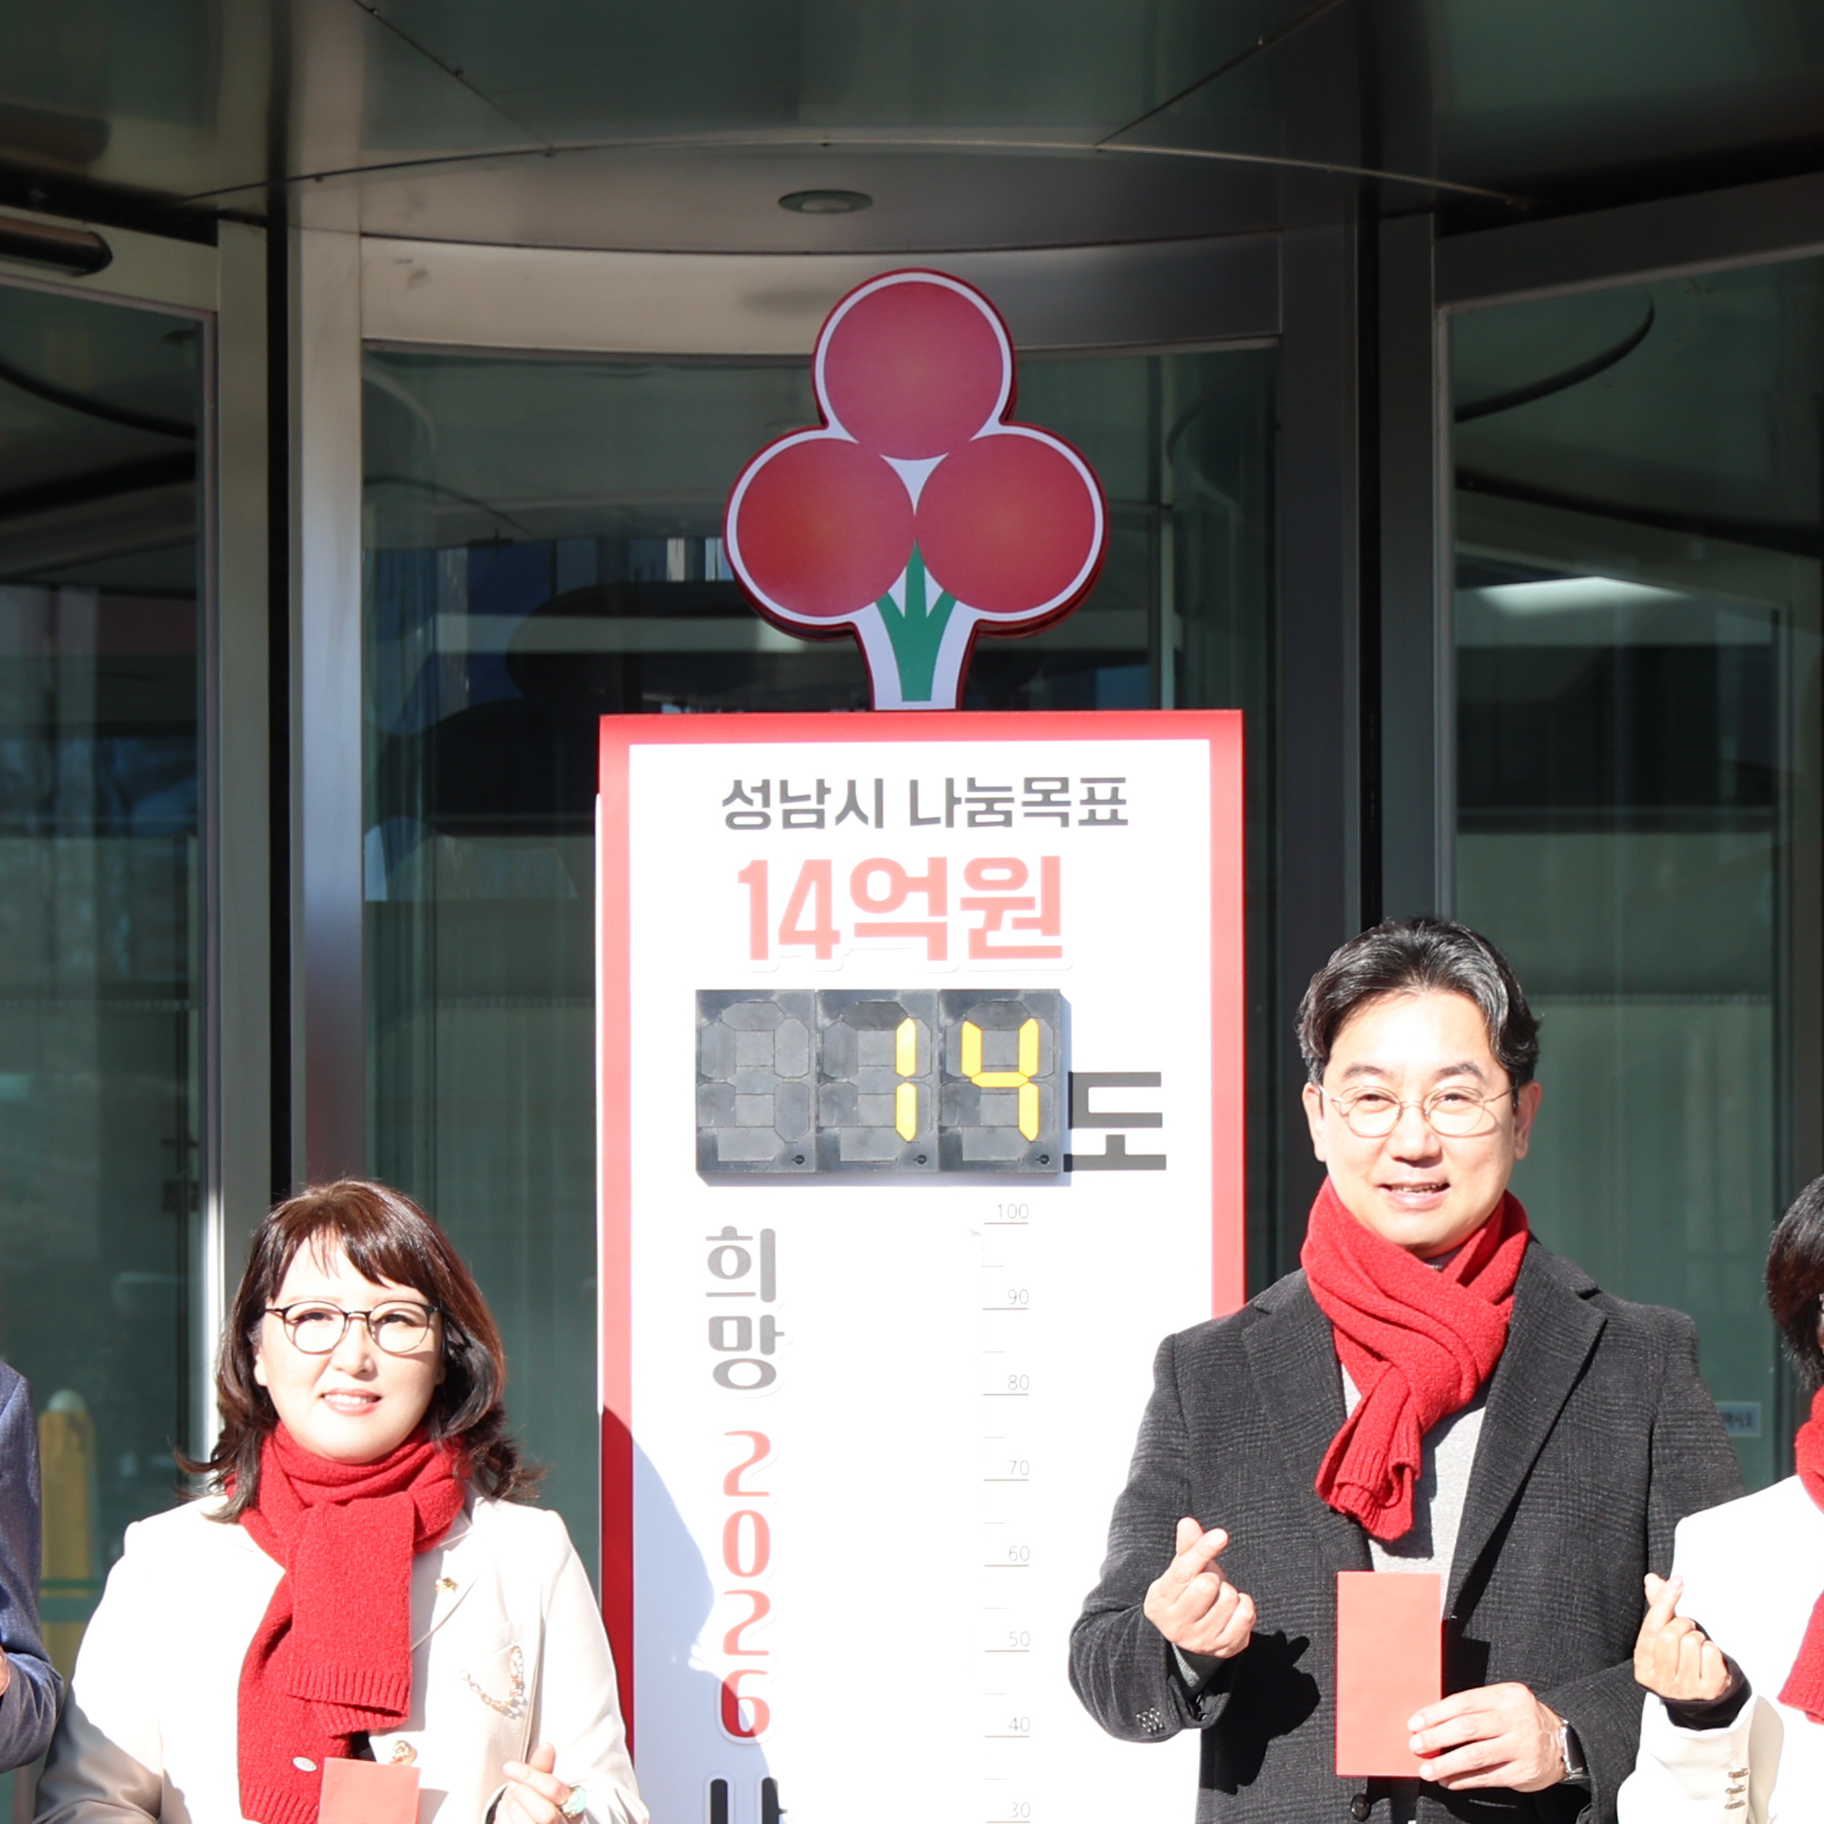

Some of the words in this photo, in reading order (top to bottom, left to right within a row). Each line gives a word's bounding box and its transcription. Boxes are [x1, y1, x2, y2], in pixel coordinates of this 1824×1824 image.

[722, 778, 884, 830] 성남시
[910, 777, 1128, 828] 나눔목표
[738, 856, 1062, 961] 14억원
[896, 1018, 1040, 1141] 14
[1063, 1071, 1167, 1172] 도
[998, 1203, 1029, 1219] 100
[1008, 1289, 1029, 1305] 90
[705, 1226, 785, 1390] 희망
[1008, 1374, 1029, 1391] 80
[1009, 1460, 1030, 1476] 70
[1008, 1546, 1030, 1561] 60
[721, 1431, 770, 1738] 2026
[1009, 1631, 1030, 1647] 50
[1009, 1717, 1030, 1732] 40
[1010, 1802, 1031, 1818] 30
